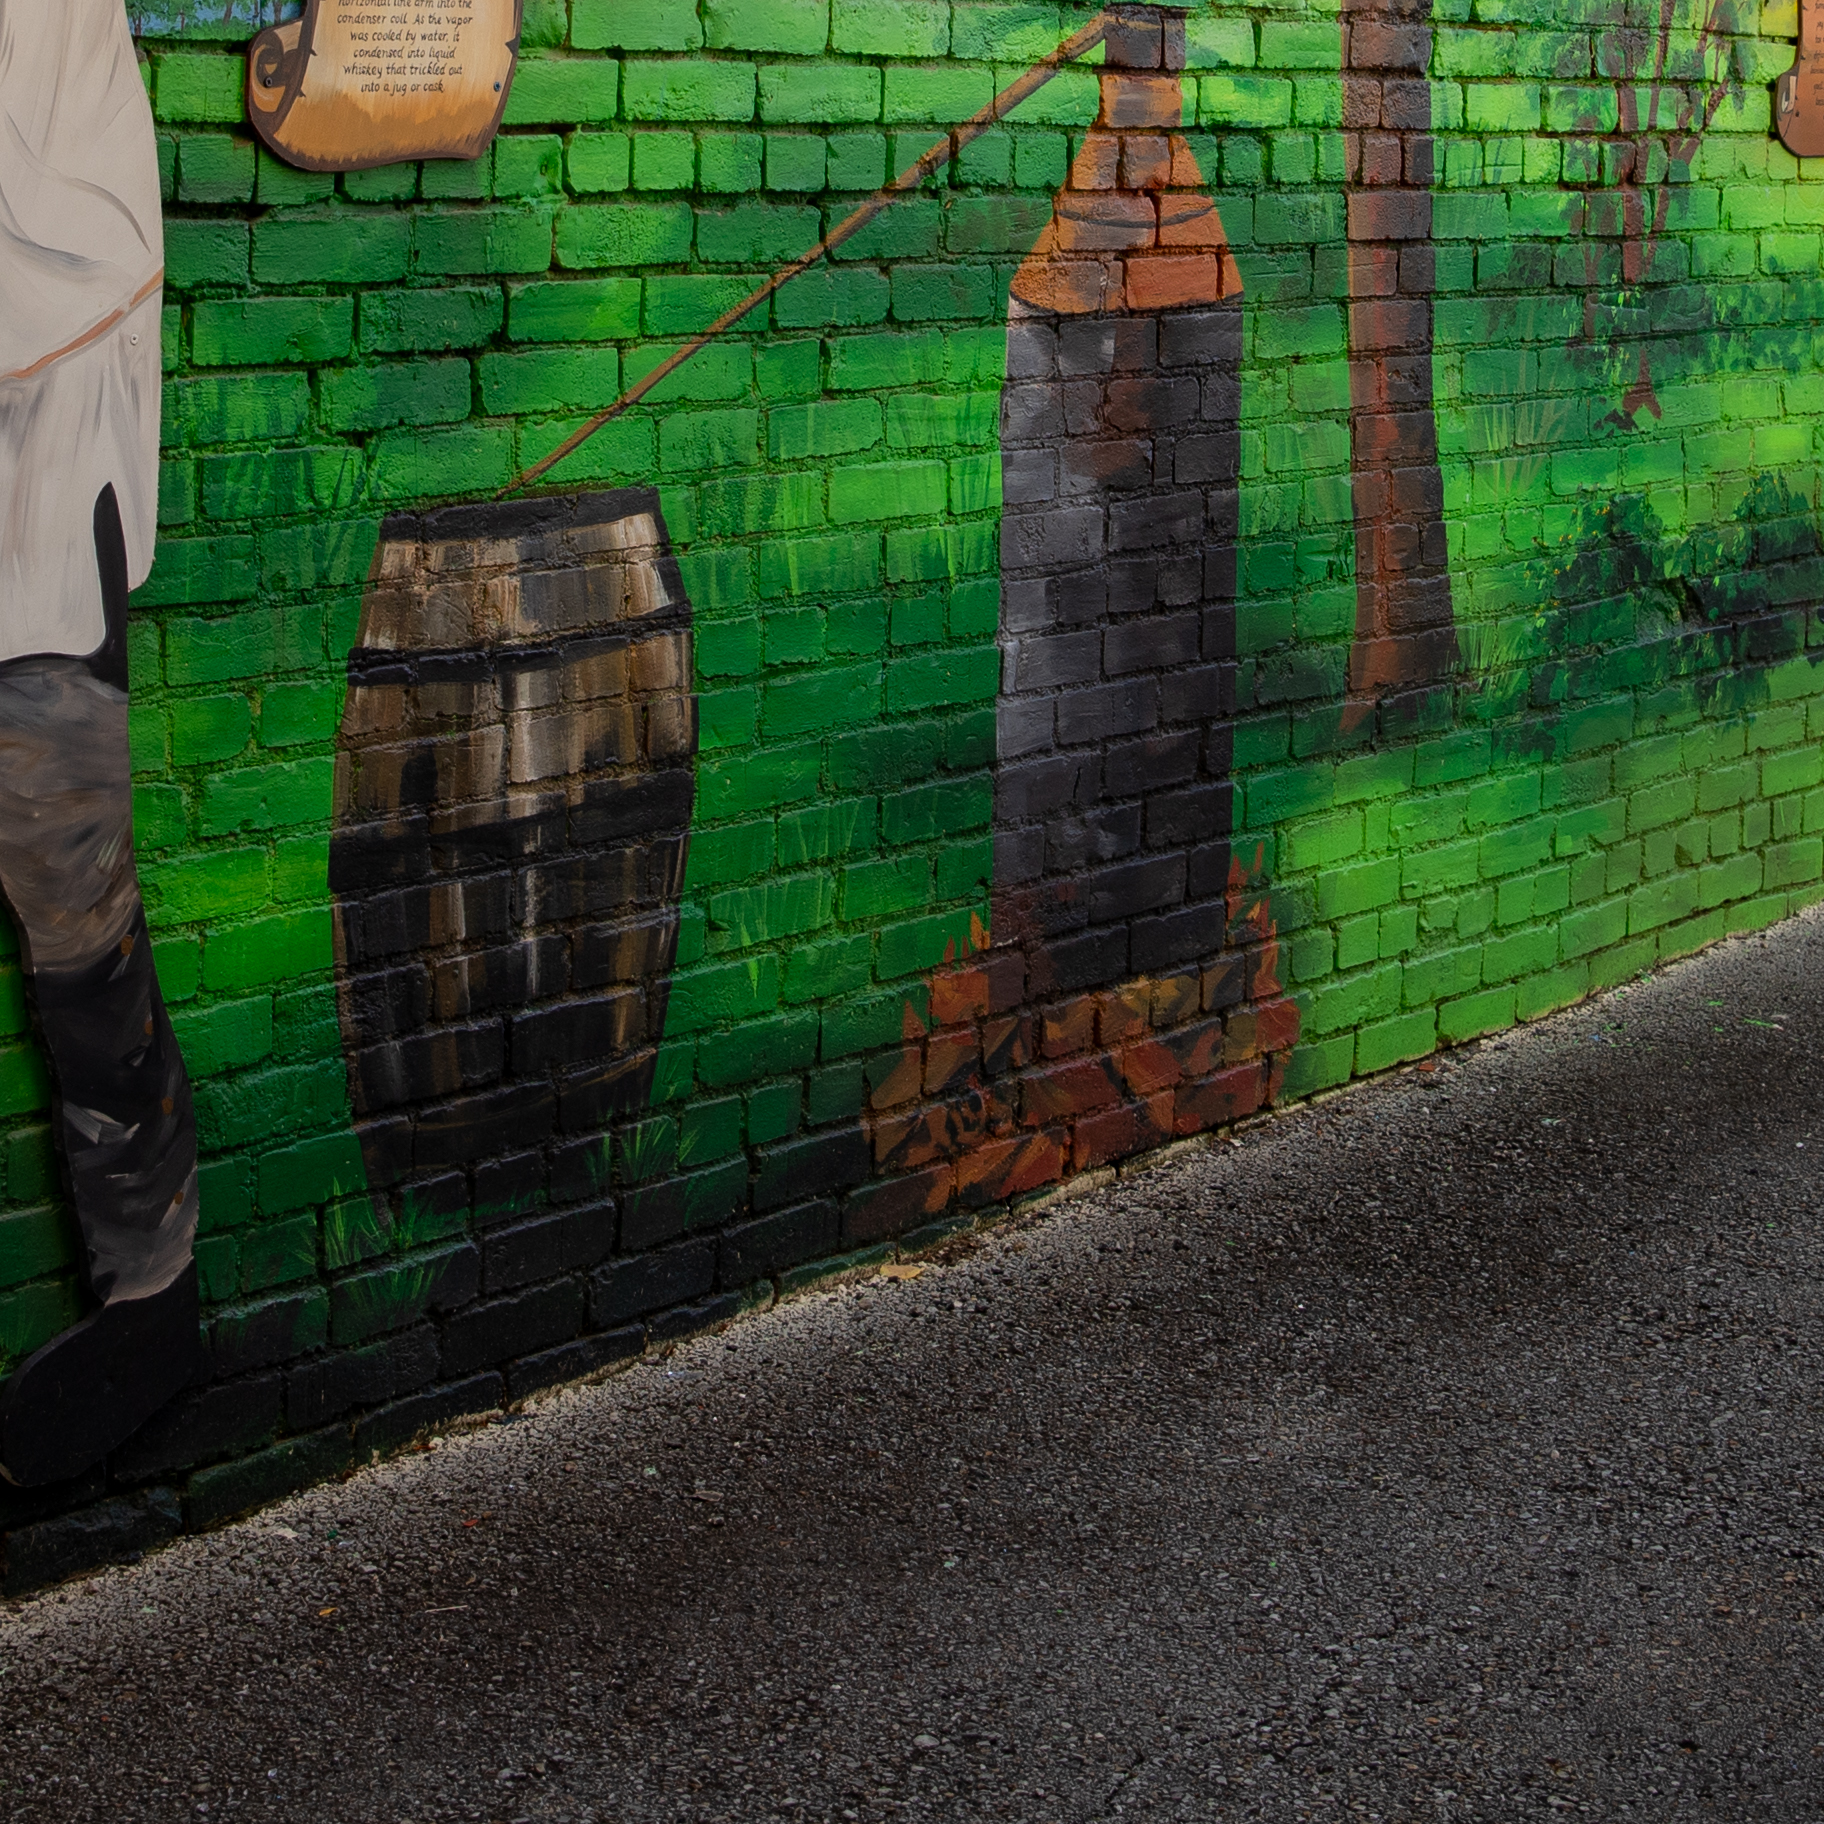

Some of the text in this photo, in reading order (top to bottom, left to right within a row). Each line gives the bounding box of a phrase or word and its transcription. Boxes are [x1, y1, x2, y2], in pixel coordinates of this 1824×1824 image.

[337, 12, 387, 24] condenser
[414, 13, 425, 25] As
[428, 12, 441, 25] the
[446, 15, 473, 32] vapor
[350, 29, 460, 45] was cooled by water, it
[353, 46, 457, 62] condensed into liquid
[343, 61, 462, 79] whiskey that trickled out
[361, 82, 380, 92] into
[390, 82, 407, 96] jug
